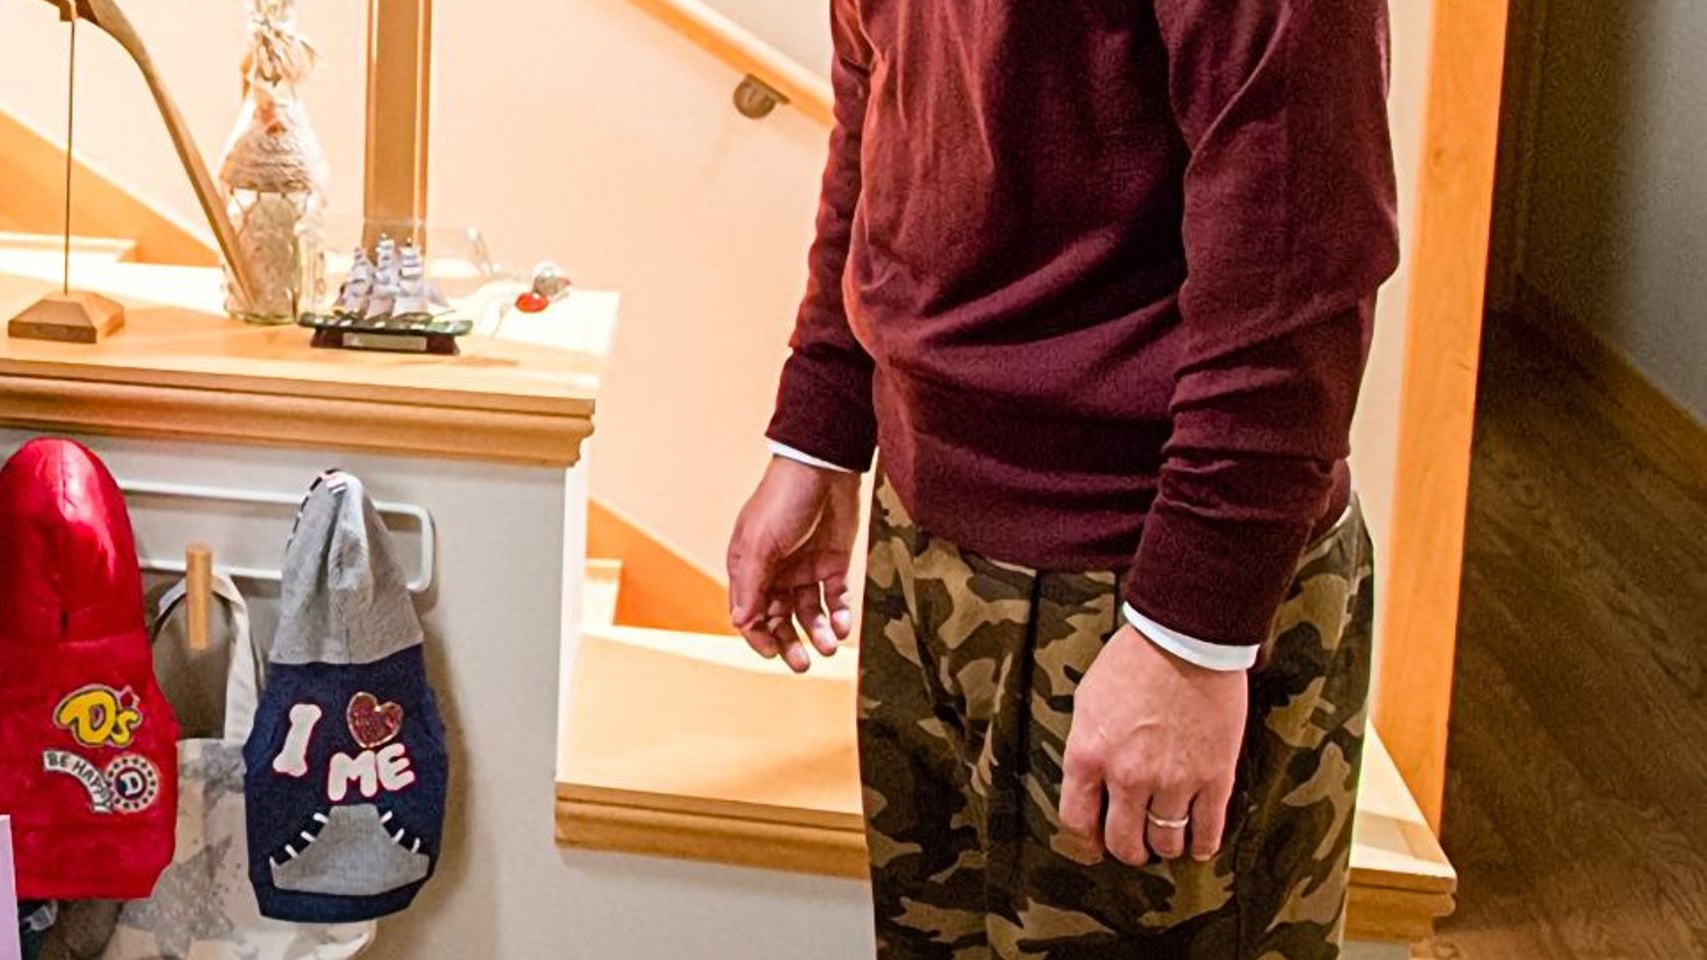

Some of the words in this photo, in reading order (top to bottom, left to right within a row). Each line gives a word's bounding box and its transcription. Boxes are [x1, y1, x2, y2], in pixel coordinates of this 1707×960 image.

[46, 751, 69, 768] BE
[72, 761, 115, 810] HAPPY
[272, 703, 322, 777] I
[327, 742, 416, 802] ME
[119, 771, 143, 796] D
